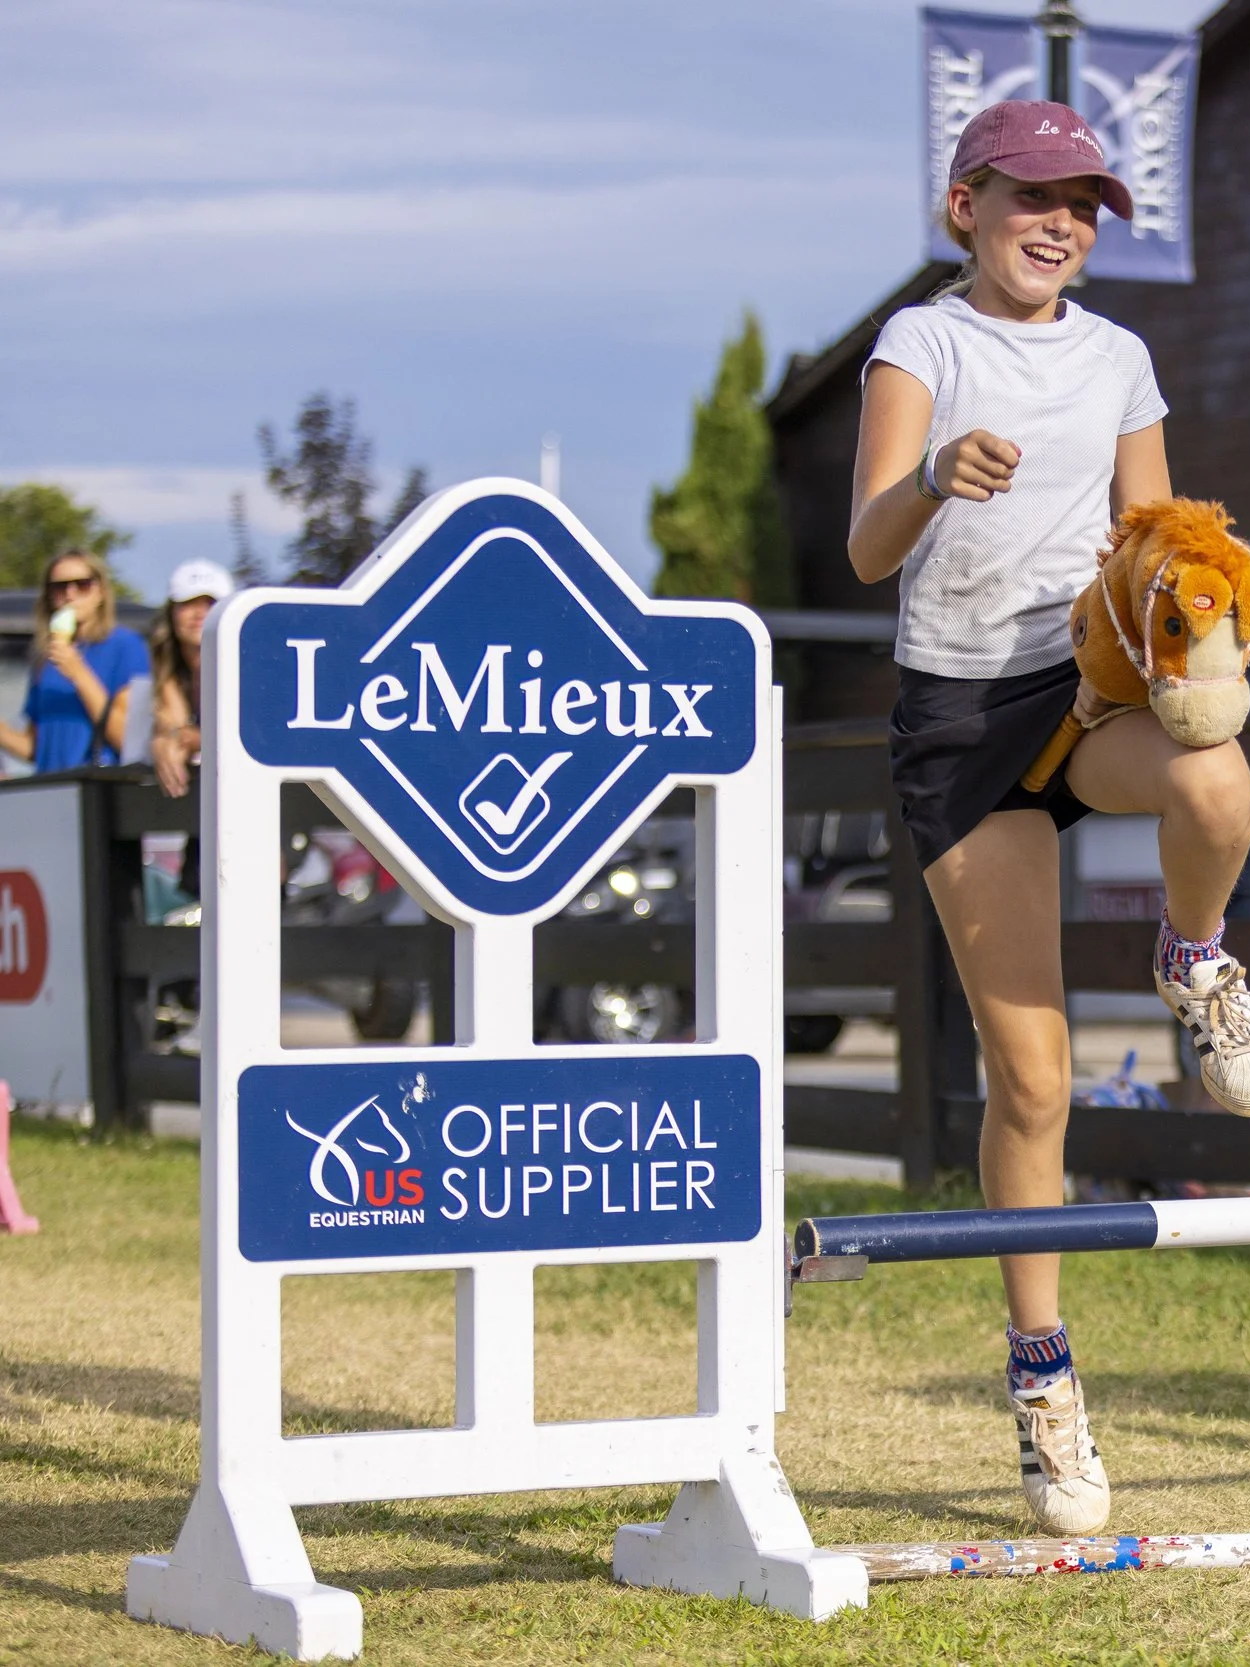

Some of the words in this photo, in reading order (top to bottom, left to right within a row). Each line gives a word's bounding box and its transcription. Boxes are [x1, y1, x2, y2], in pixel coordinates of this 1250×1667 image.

[1035, 119, 1060, 135] Le
[286, 639, 713, 738] LeMieux
[442, 1100, 718, 1158] OFFICIAL
[366, 1169, 425, 1207] US
[439, 1161, 716, 1221] SUPPLIER
[310, 1209, 425, 1228] EQUESTRIAN
